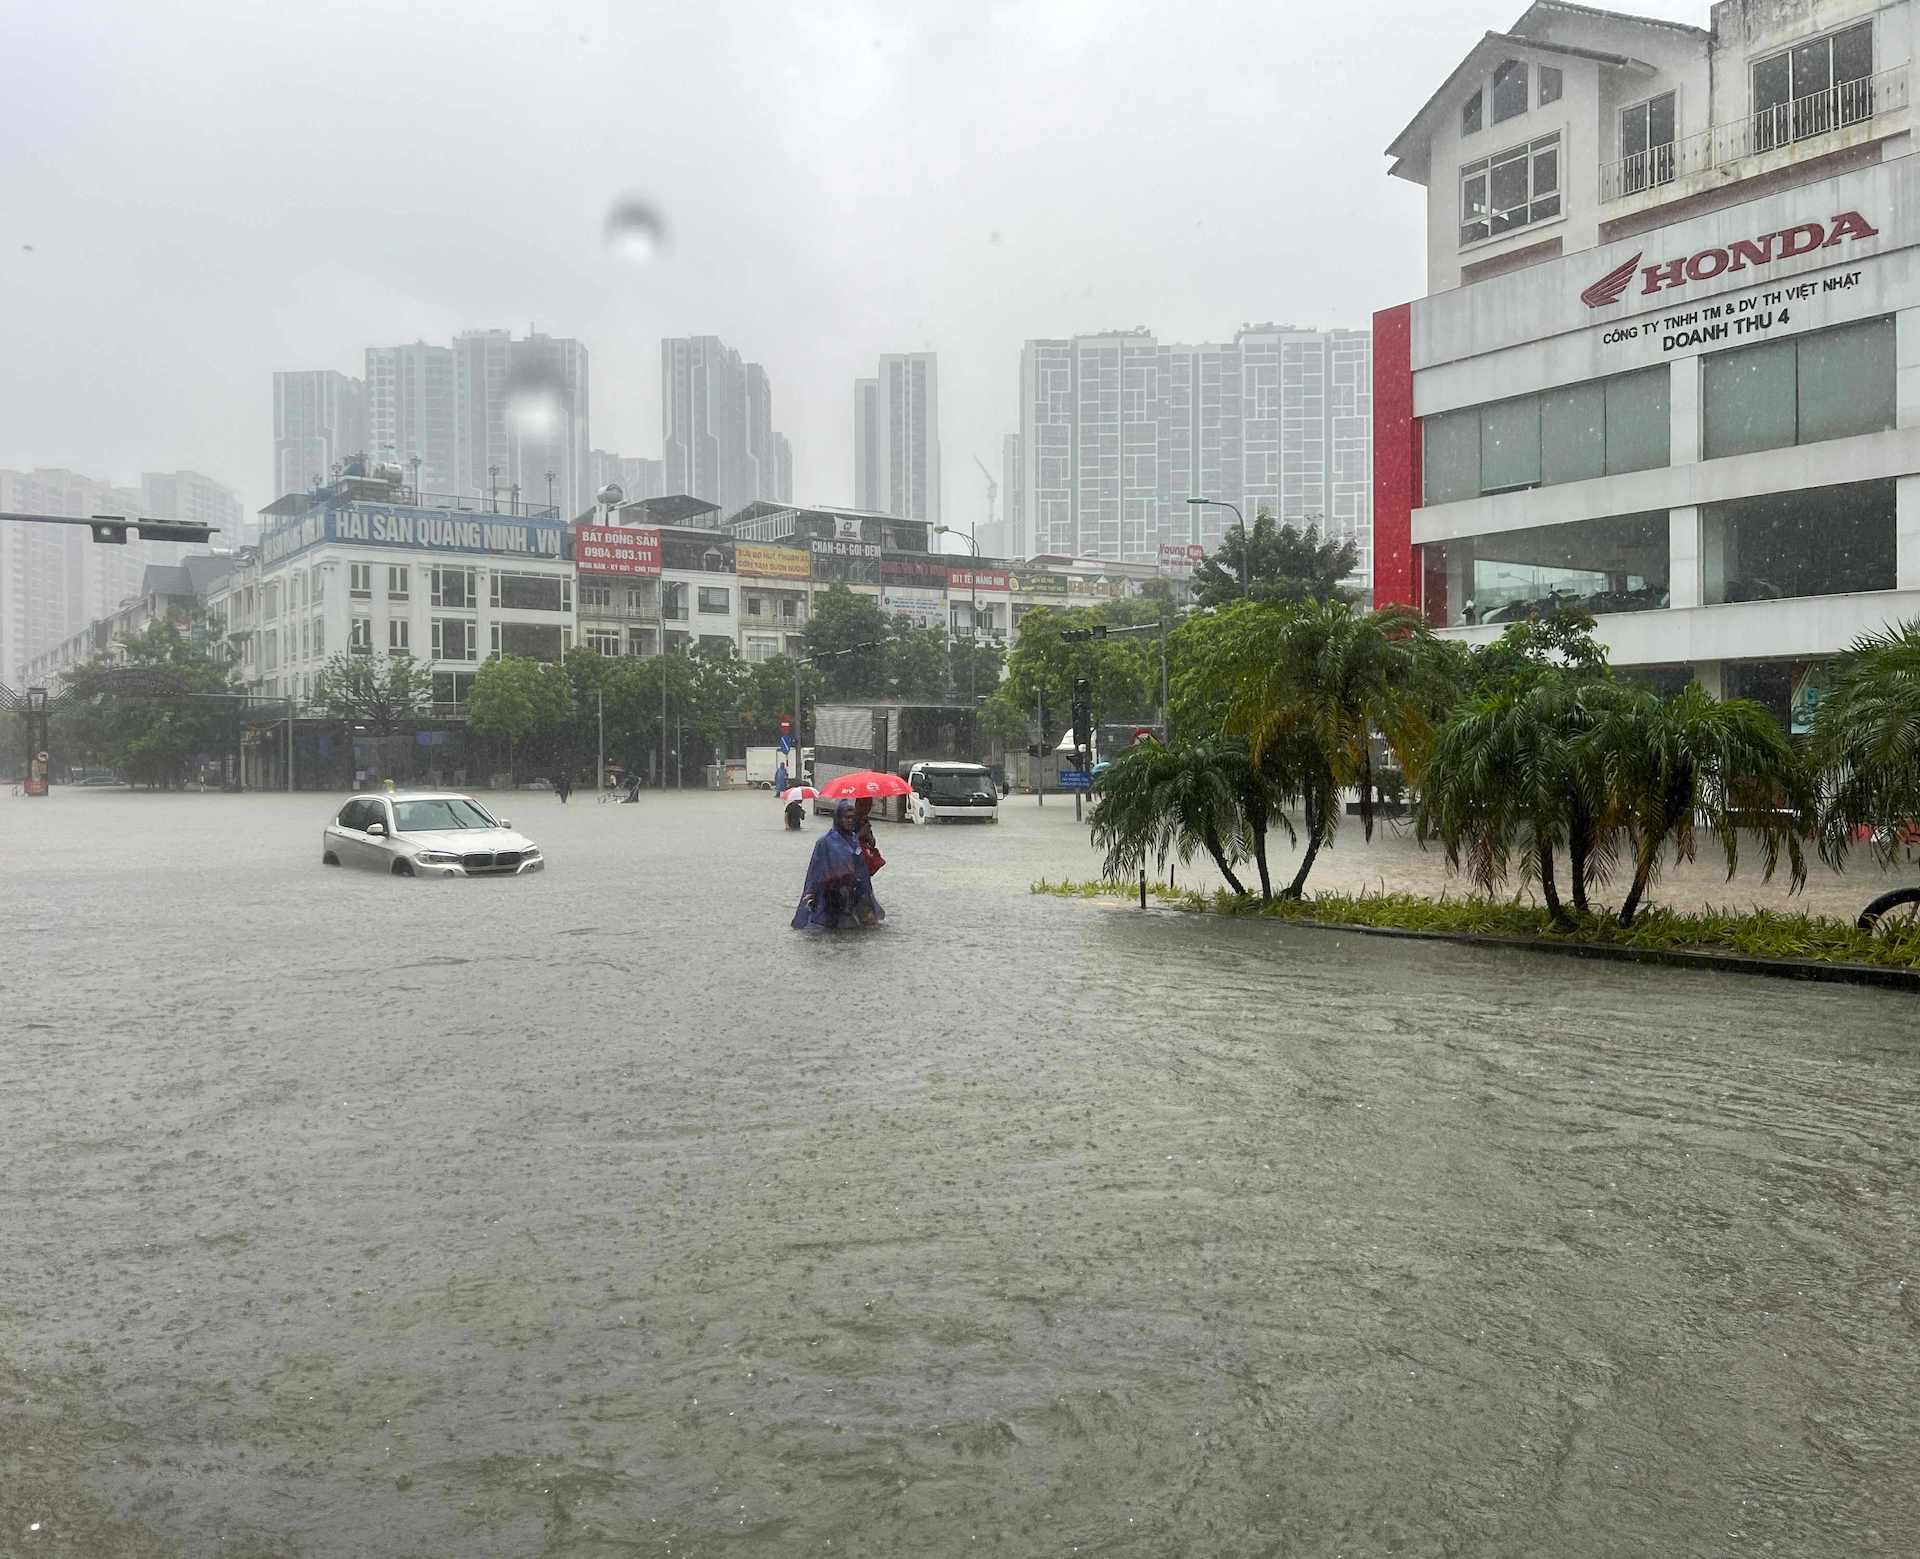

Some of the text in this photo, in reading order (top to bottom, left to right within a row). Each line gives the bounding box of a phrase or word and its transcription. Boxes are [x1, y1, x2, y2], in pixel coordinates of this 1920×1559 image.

[1641, 210, 1879, 295] HONDA
[1603, 326, 1638, 344] CÔNG
[1642, 320, 1661, 335] TY
[1663, 311, 1698, 330] TNHH
[1702, 306, 1722, 321] TM
[1725, 303, 1736, 315] &
[1739, 296, 1759, 312] DV
[1762, 291, 1782, 306] TH
[1662, 308, 1791, 352] DOANH THU 4
[372, 507, 413, 543] SẢN
